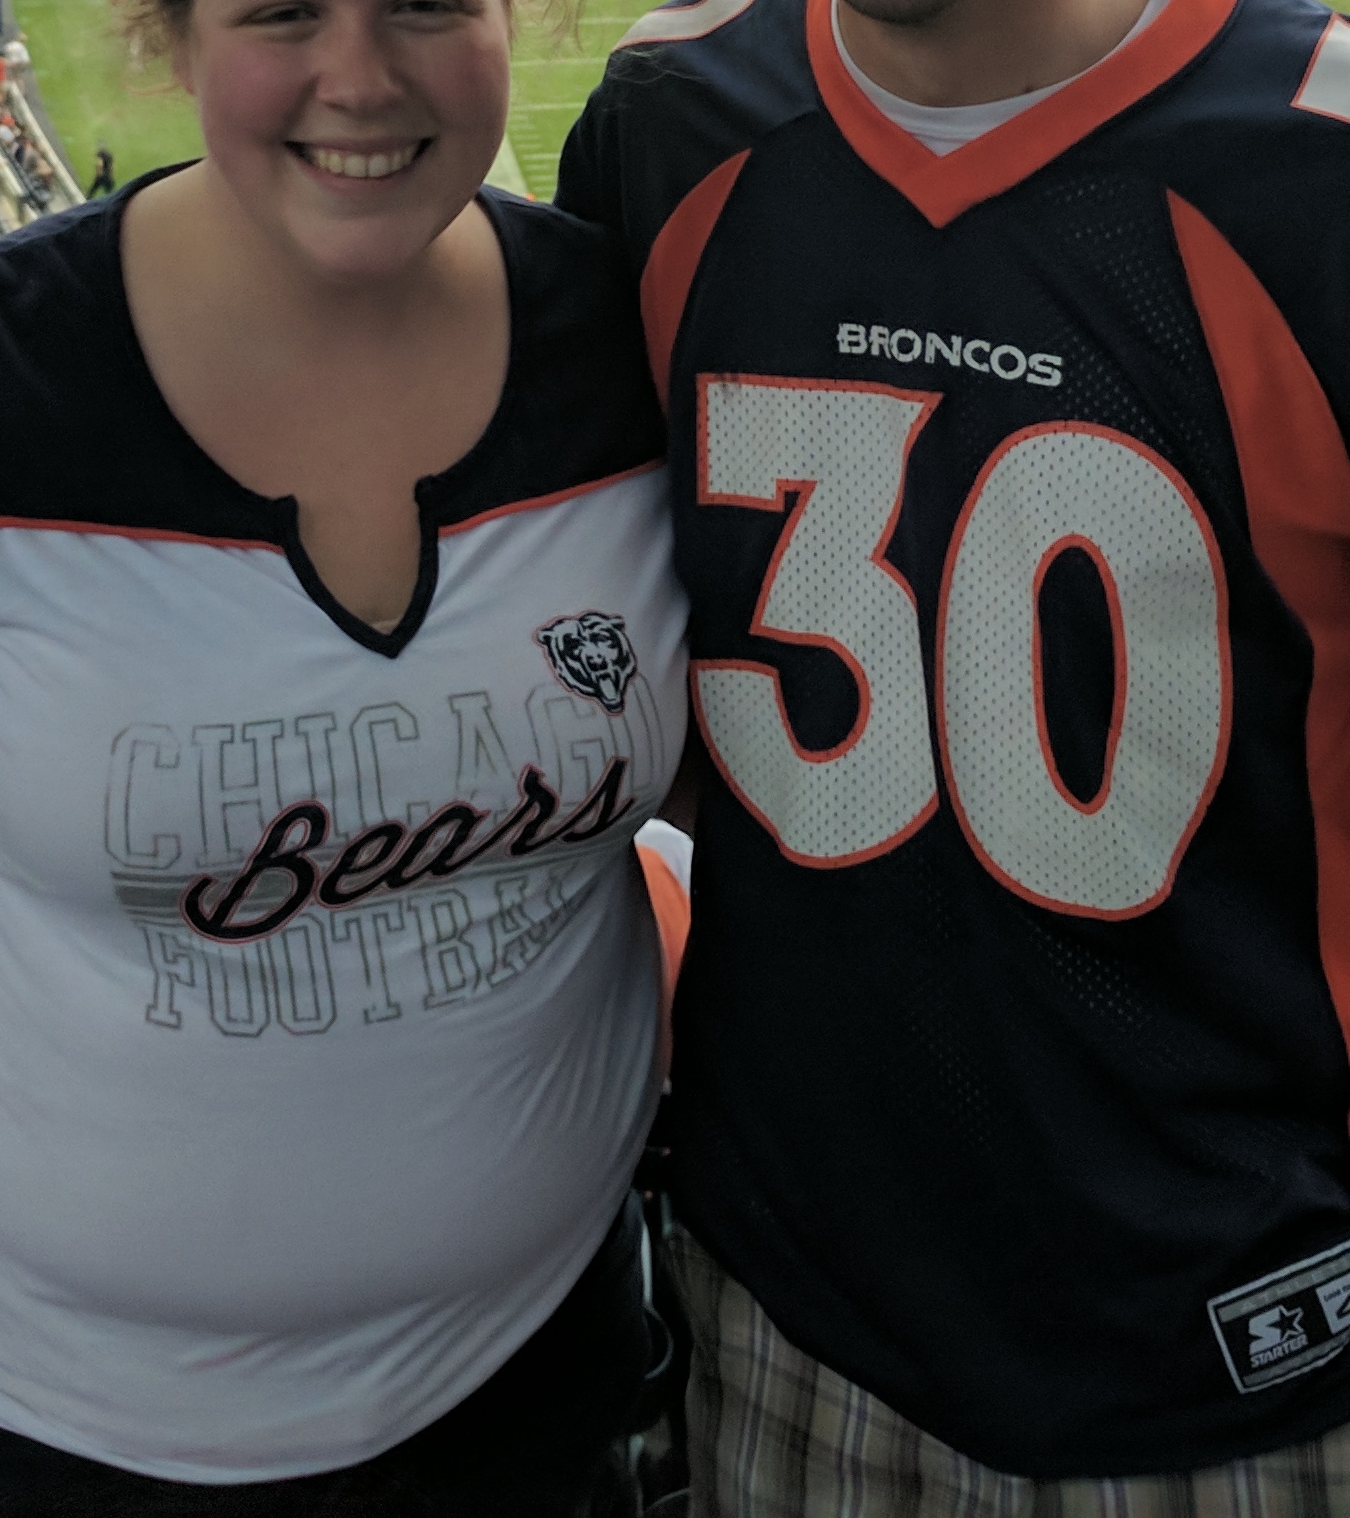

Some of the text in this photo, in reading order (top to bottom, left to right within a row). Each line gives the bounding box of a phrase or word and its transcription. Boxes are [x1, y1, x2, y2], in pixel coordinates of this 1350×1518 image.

[836, 322, 1063, 388] BRONCOS
[693, 372, 1233, 922] 30
[104, 671, 667, 870] CHICAGO
[181, 756, 635, 944] Bears
[1250, 1333, 1309, 1369] STARTER
